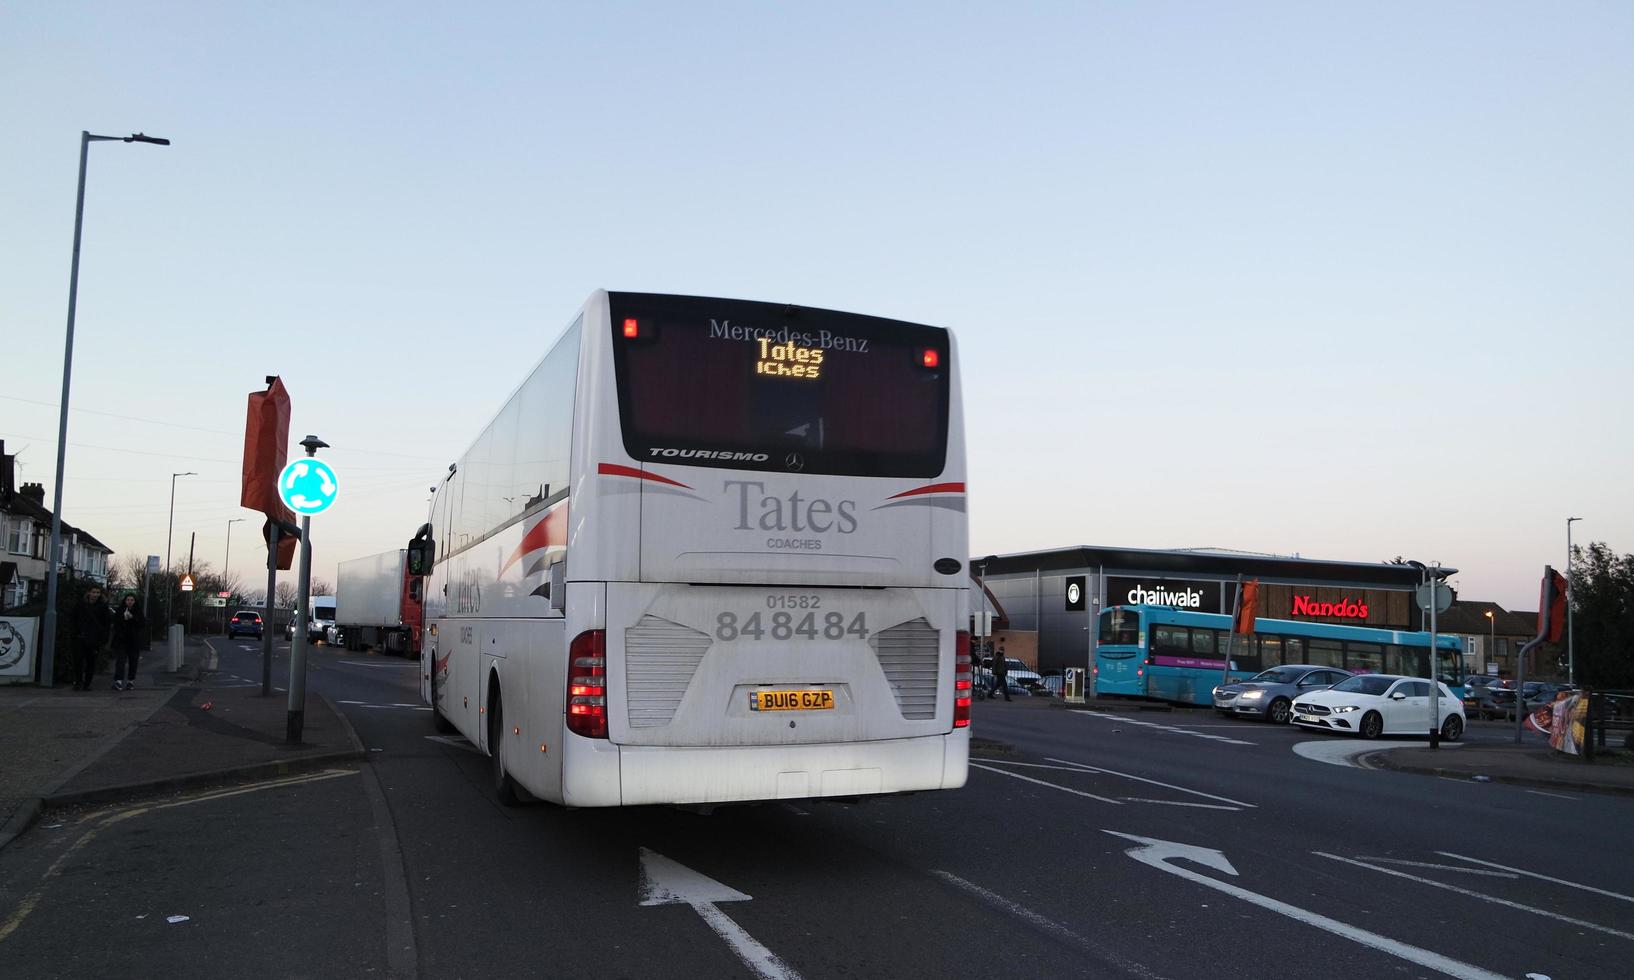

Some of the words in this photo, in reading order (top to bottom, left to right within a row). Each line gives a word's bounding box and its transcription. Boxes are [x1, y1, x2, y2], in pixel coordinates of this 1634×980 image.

[709, 318, 869, 353] Mercedes-Benz
[757, 337, 825, 364] Tates
[649, 447, 769, 463] TOURISMO
[723, 480, 858, 534] Tates
[767, 538, 822, 550] COACHES
[766, 595, 821, 609] 01582
[1291, 595, 1369, 619] Nando's
[764, 693, 799, 708] BU16
[802, 692, 831, 707] GZP
